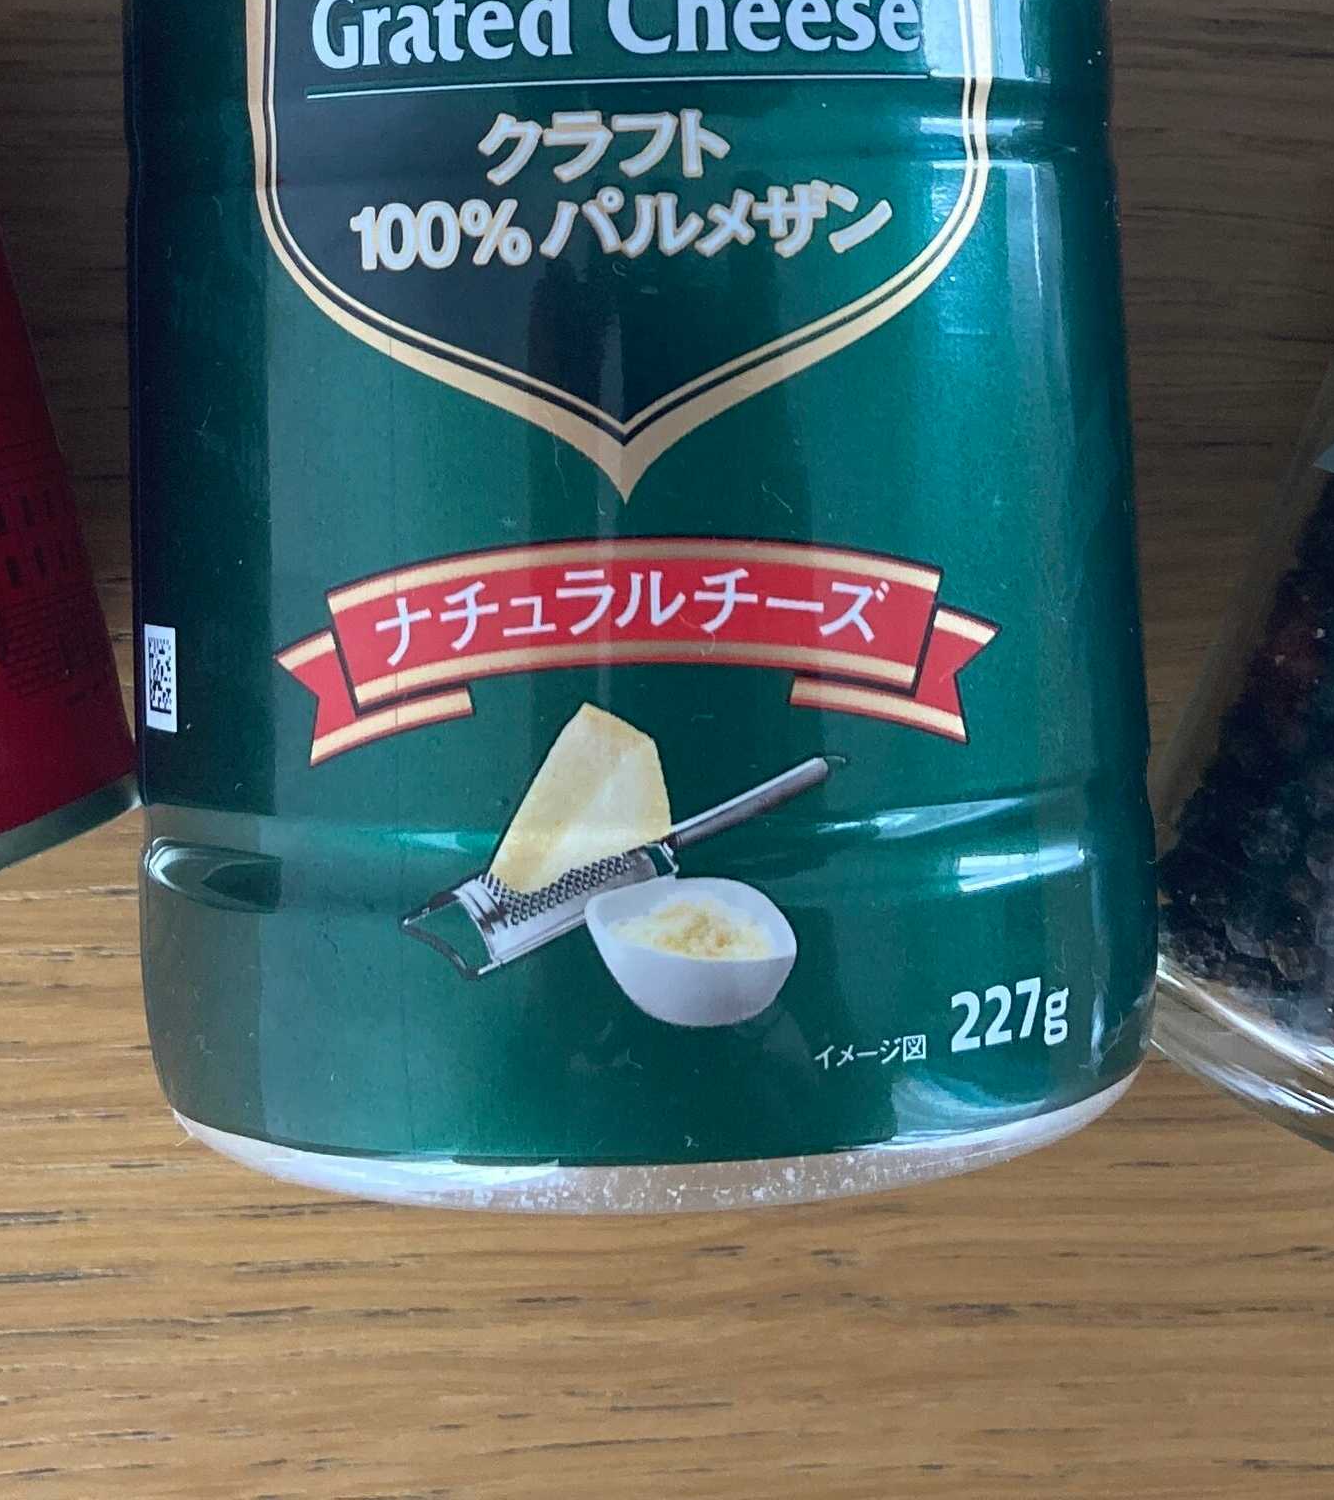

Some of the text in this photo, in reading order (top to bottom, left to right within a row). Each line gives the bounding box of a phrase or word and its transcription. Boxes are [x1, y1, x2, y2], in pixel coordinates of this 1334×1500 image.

[479, 107, 732, 186] クラフト
[373, 567, 891, 667] ナチュラルチーズ
[815, 1034, 926, 1070] イメージ図
[951, 977, 1069, 1053] 227g
